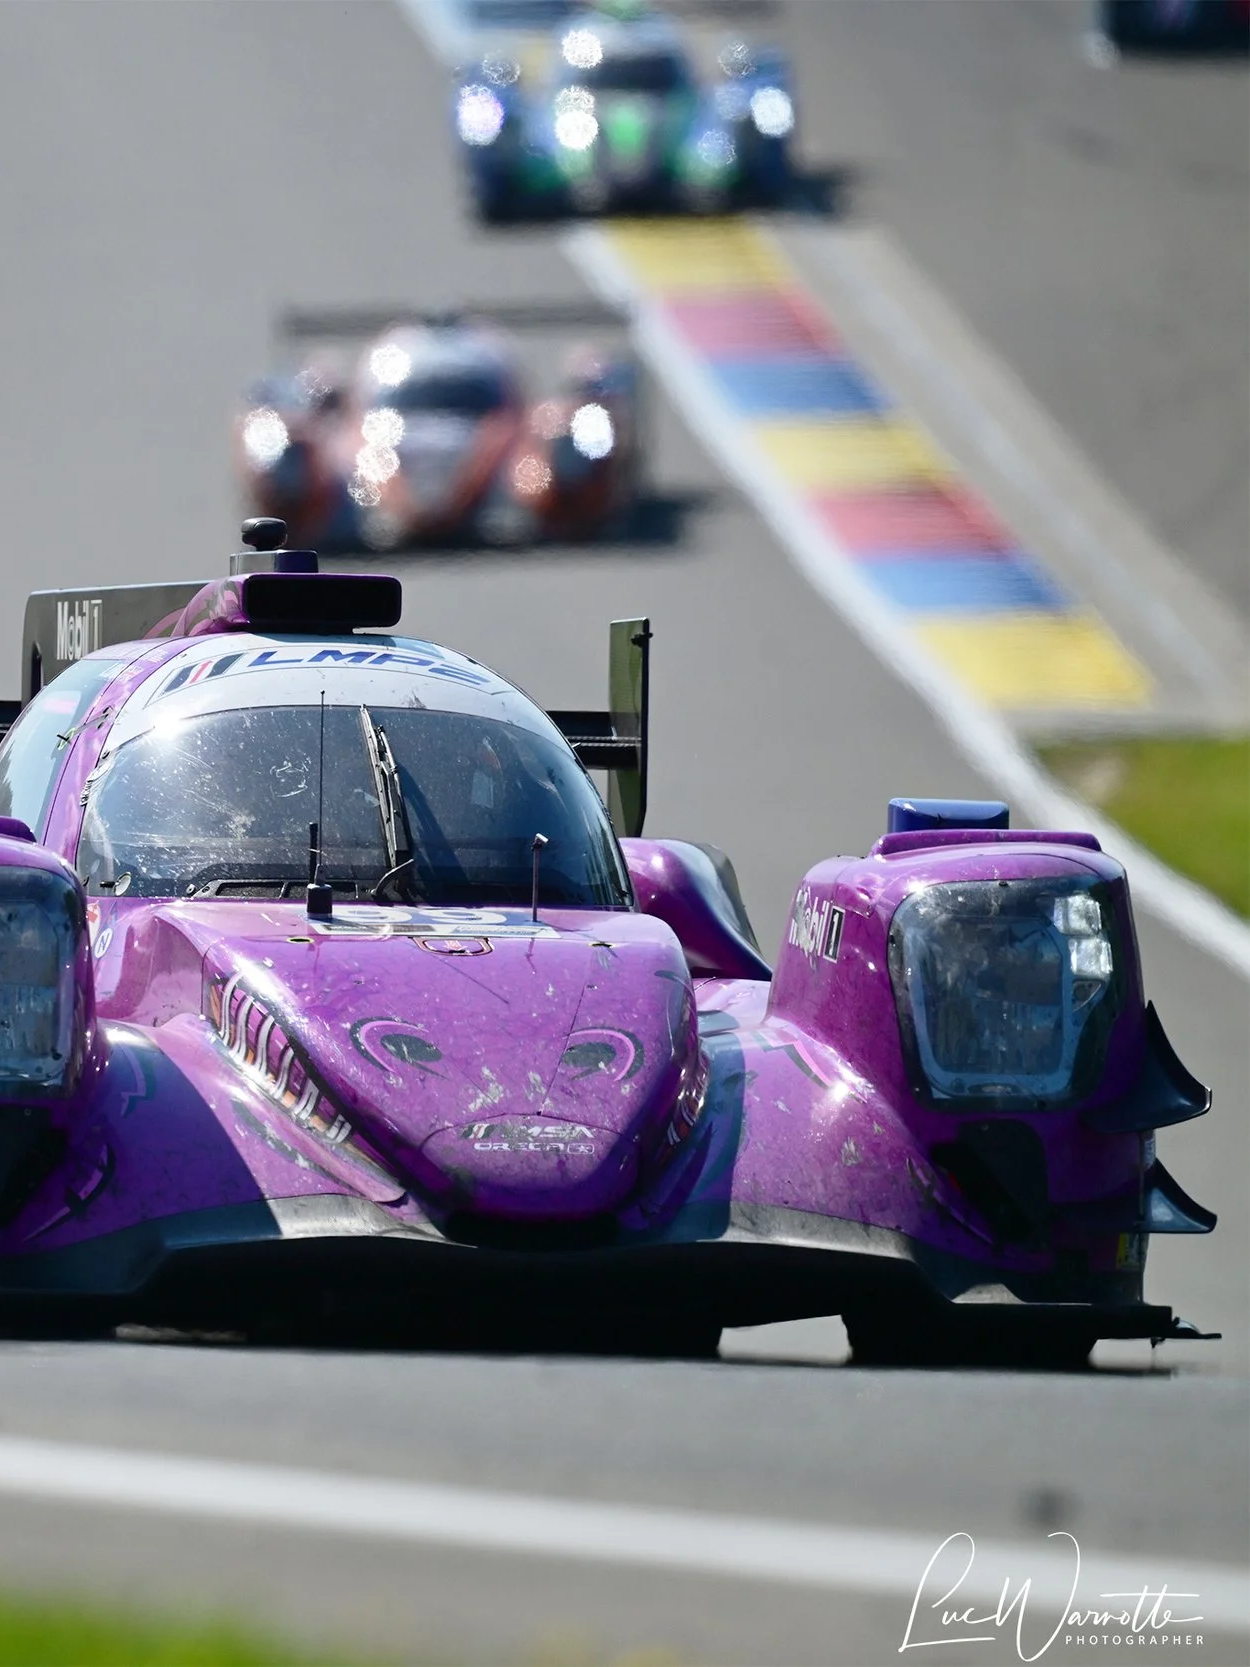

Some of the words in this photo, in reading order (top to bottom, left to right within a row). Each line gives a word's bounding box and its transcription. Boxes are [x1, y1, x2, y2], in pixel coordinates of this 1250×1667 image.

[56, 600, 89, 660] Mobil
[248, 649, 491, 686] LMP2
[826, 909, 843, 959] 1
